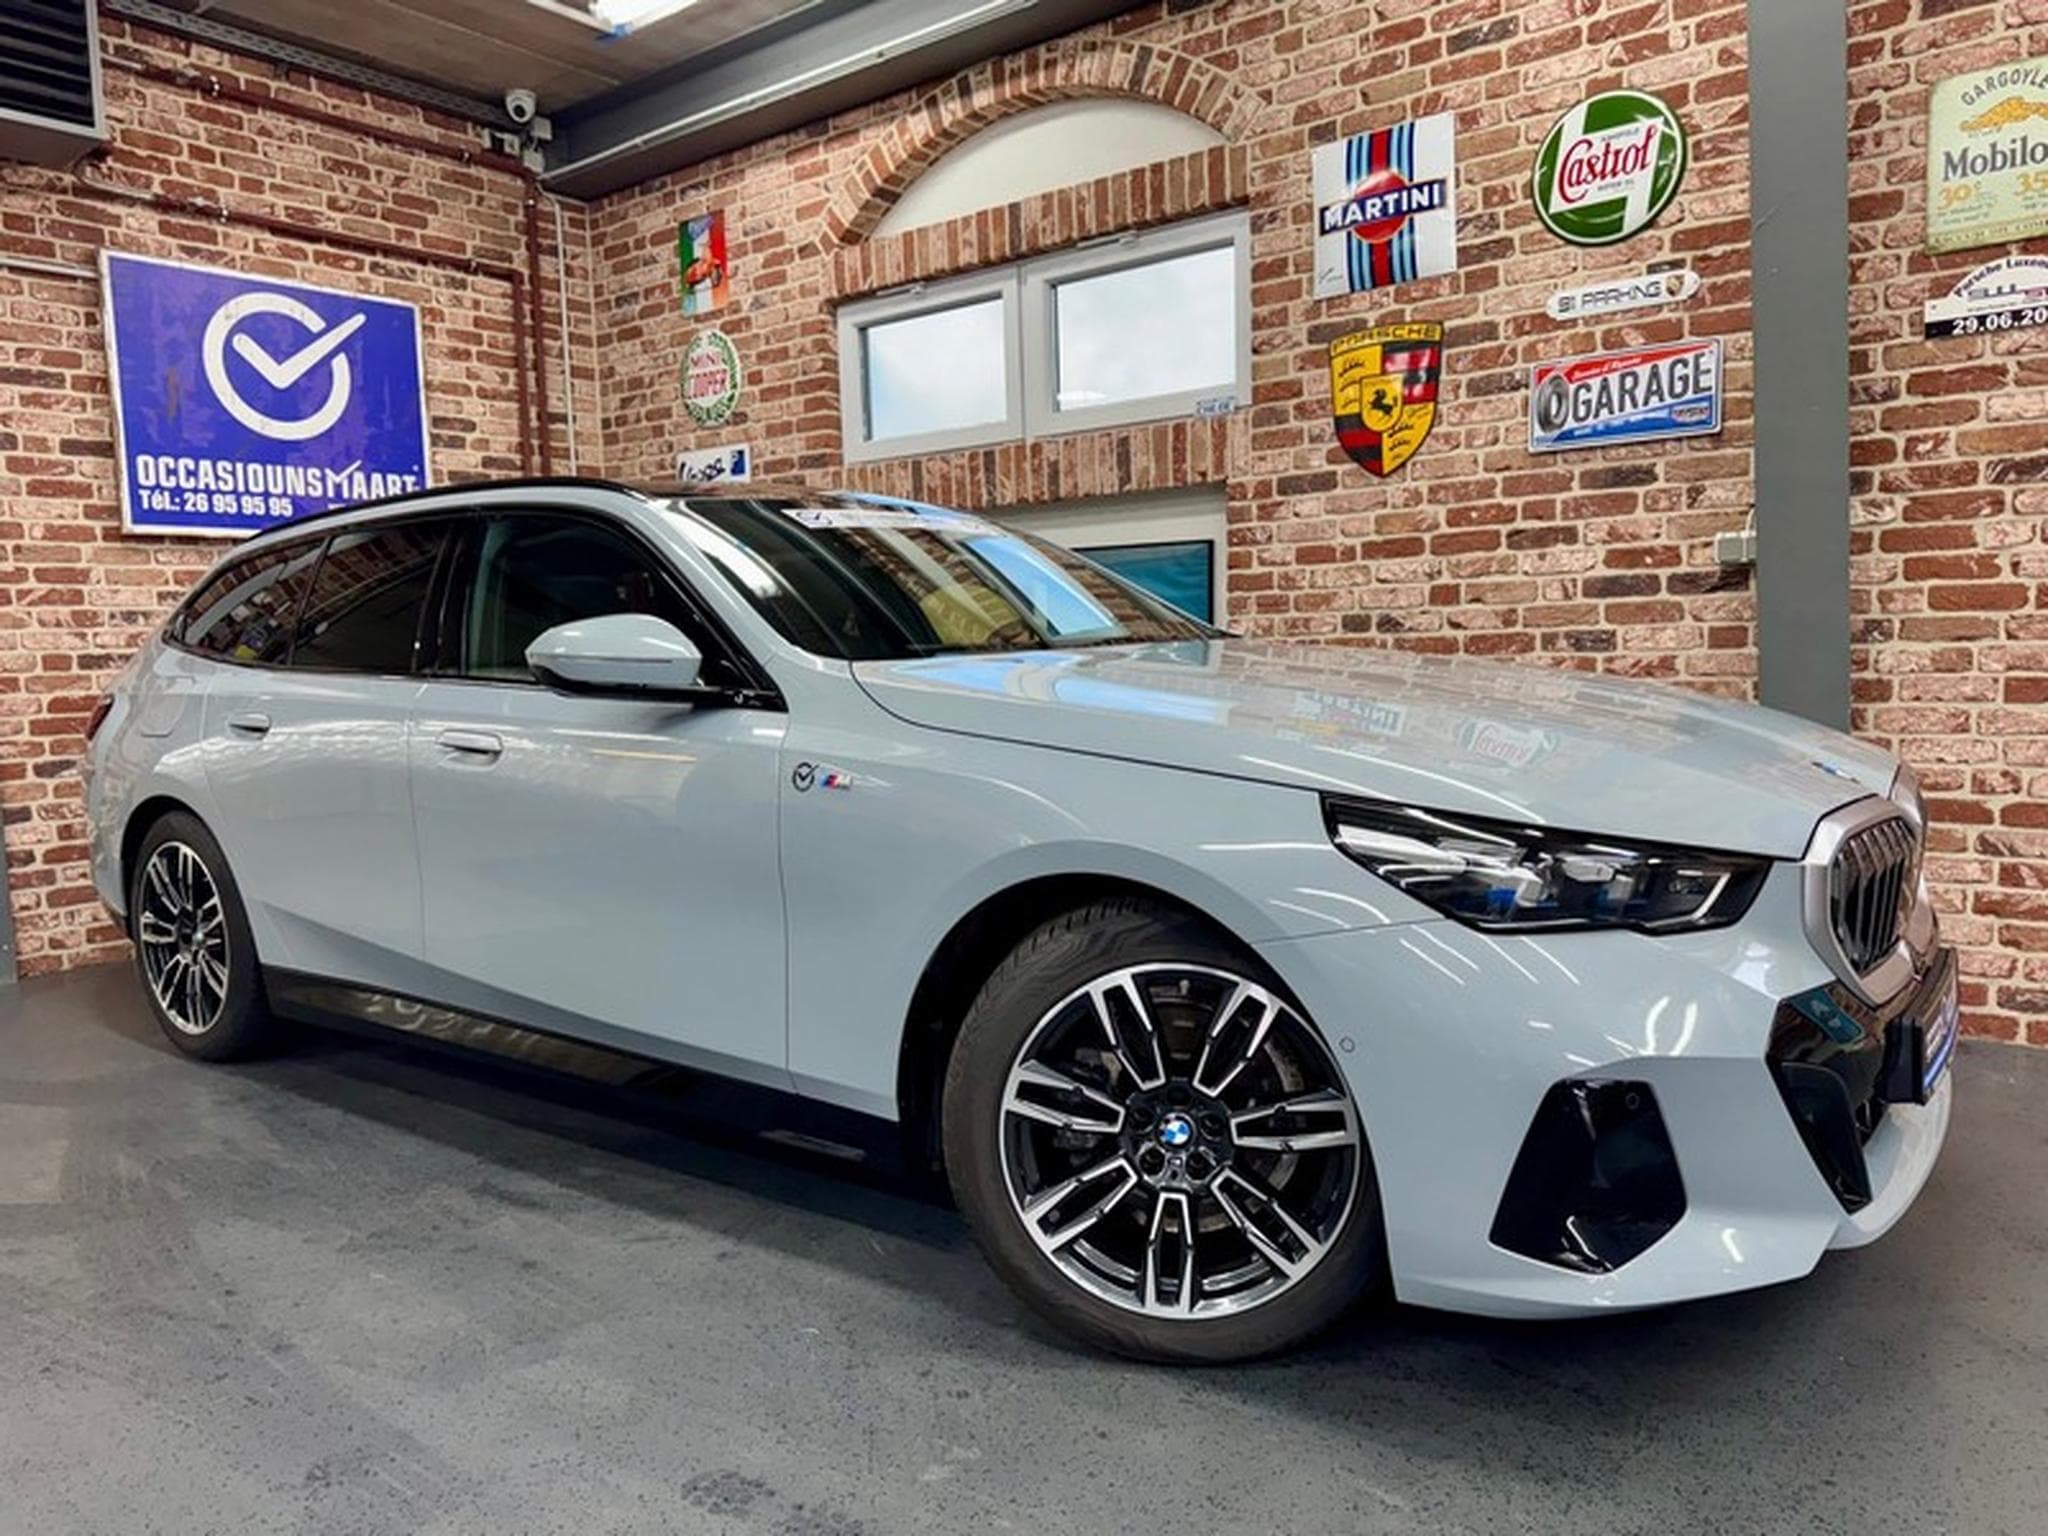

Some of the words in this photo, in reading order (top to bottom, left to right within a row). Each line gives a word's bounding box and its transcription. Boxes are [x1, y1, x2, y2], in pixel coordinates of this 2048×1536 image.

[1558, 123, 1658, 204] Castrol
[1942, 134, 2048, 183] Mobilo
[1323, 182, 1440, 231] MARTINI
[1332, 326, 1437, 352] PORSCHE
[1572, 352, 1713, 423] GARAGE
[138, 489, 180, 510] Tél.:
[183, 492, 209, 513] 26
[212, 494, 238, 515] 95
[240, 497, 266, 516] 95
[268, 498, 293, 517] 95
